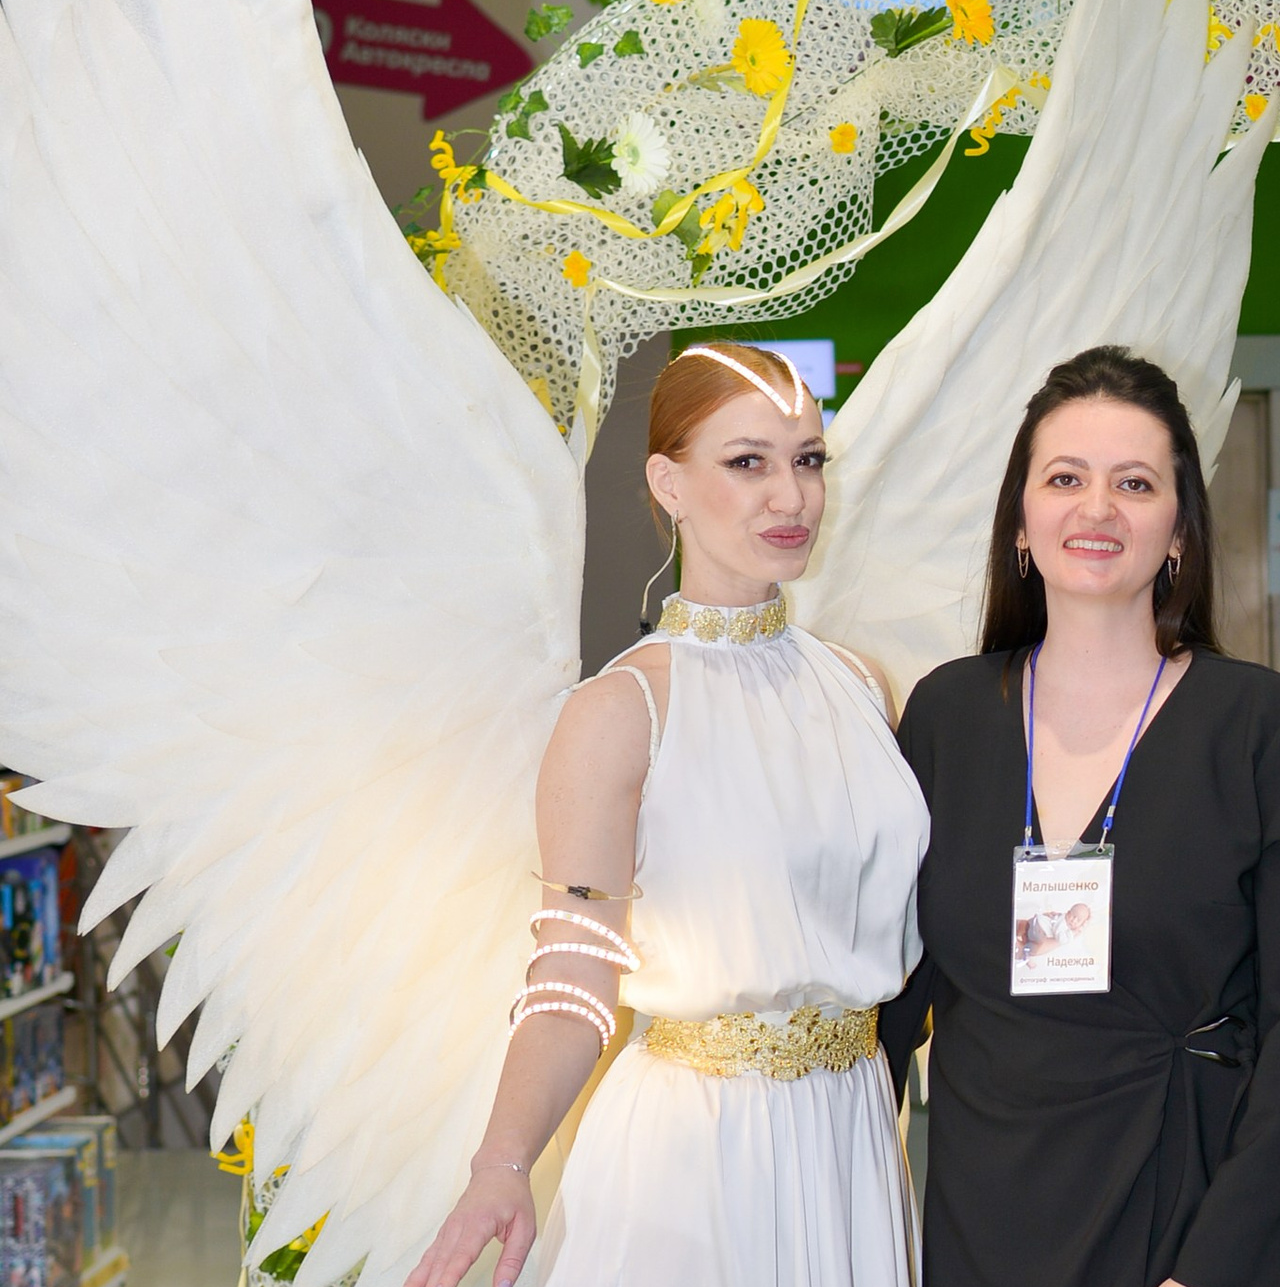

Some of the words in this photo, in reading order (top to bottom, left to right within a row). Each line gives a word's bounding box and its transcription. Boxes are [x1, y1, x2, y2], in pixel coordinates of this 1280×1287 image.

[345, 15, 452, 49] Коляски
[1022, 880, 1099, 893] Малышенко
[1047, 956, 1095, 968] Надежда
